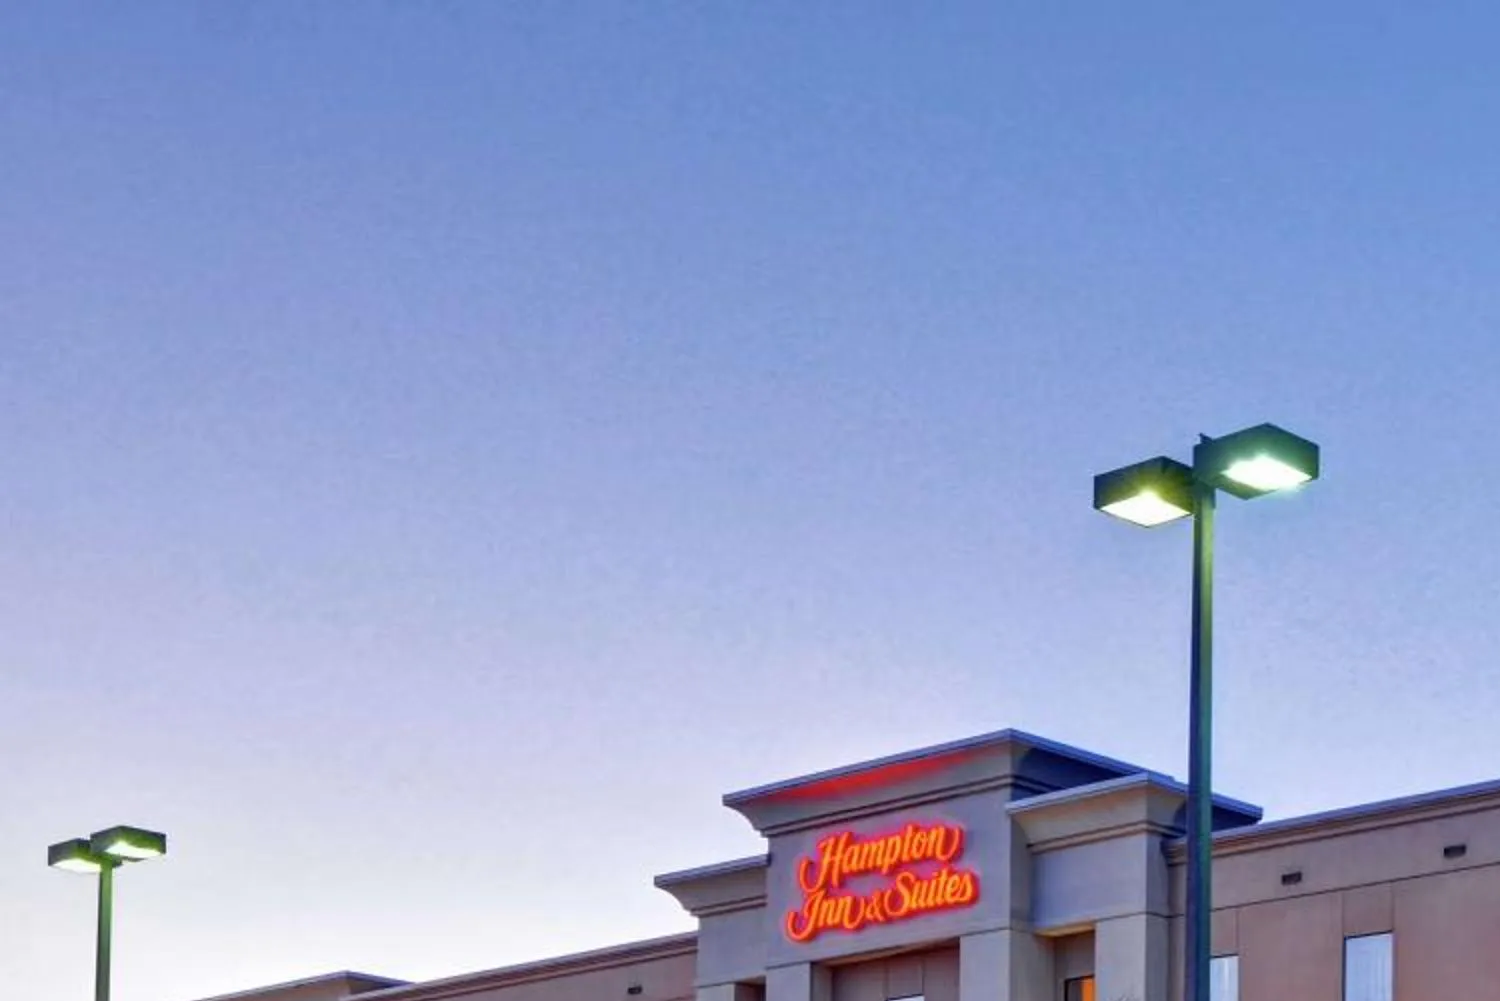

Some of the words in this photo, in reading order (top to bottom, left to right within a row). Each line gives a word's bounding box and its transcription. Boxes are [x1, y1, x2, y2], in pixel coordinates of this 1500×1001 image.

[799, 823, 965, 893] Hampton
[786, 889, 866, 942] Inn
[866, 893, 885, 923] &
[884, 866, 977, 917] Suites
